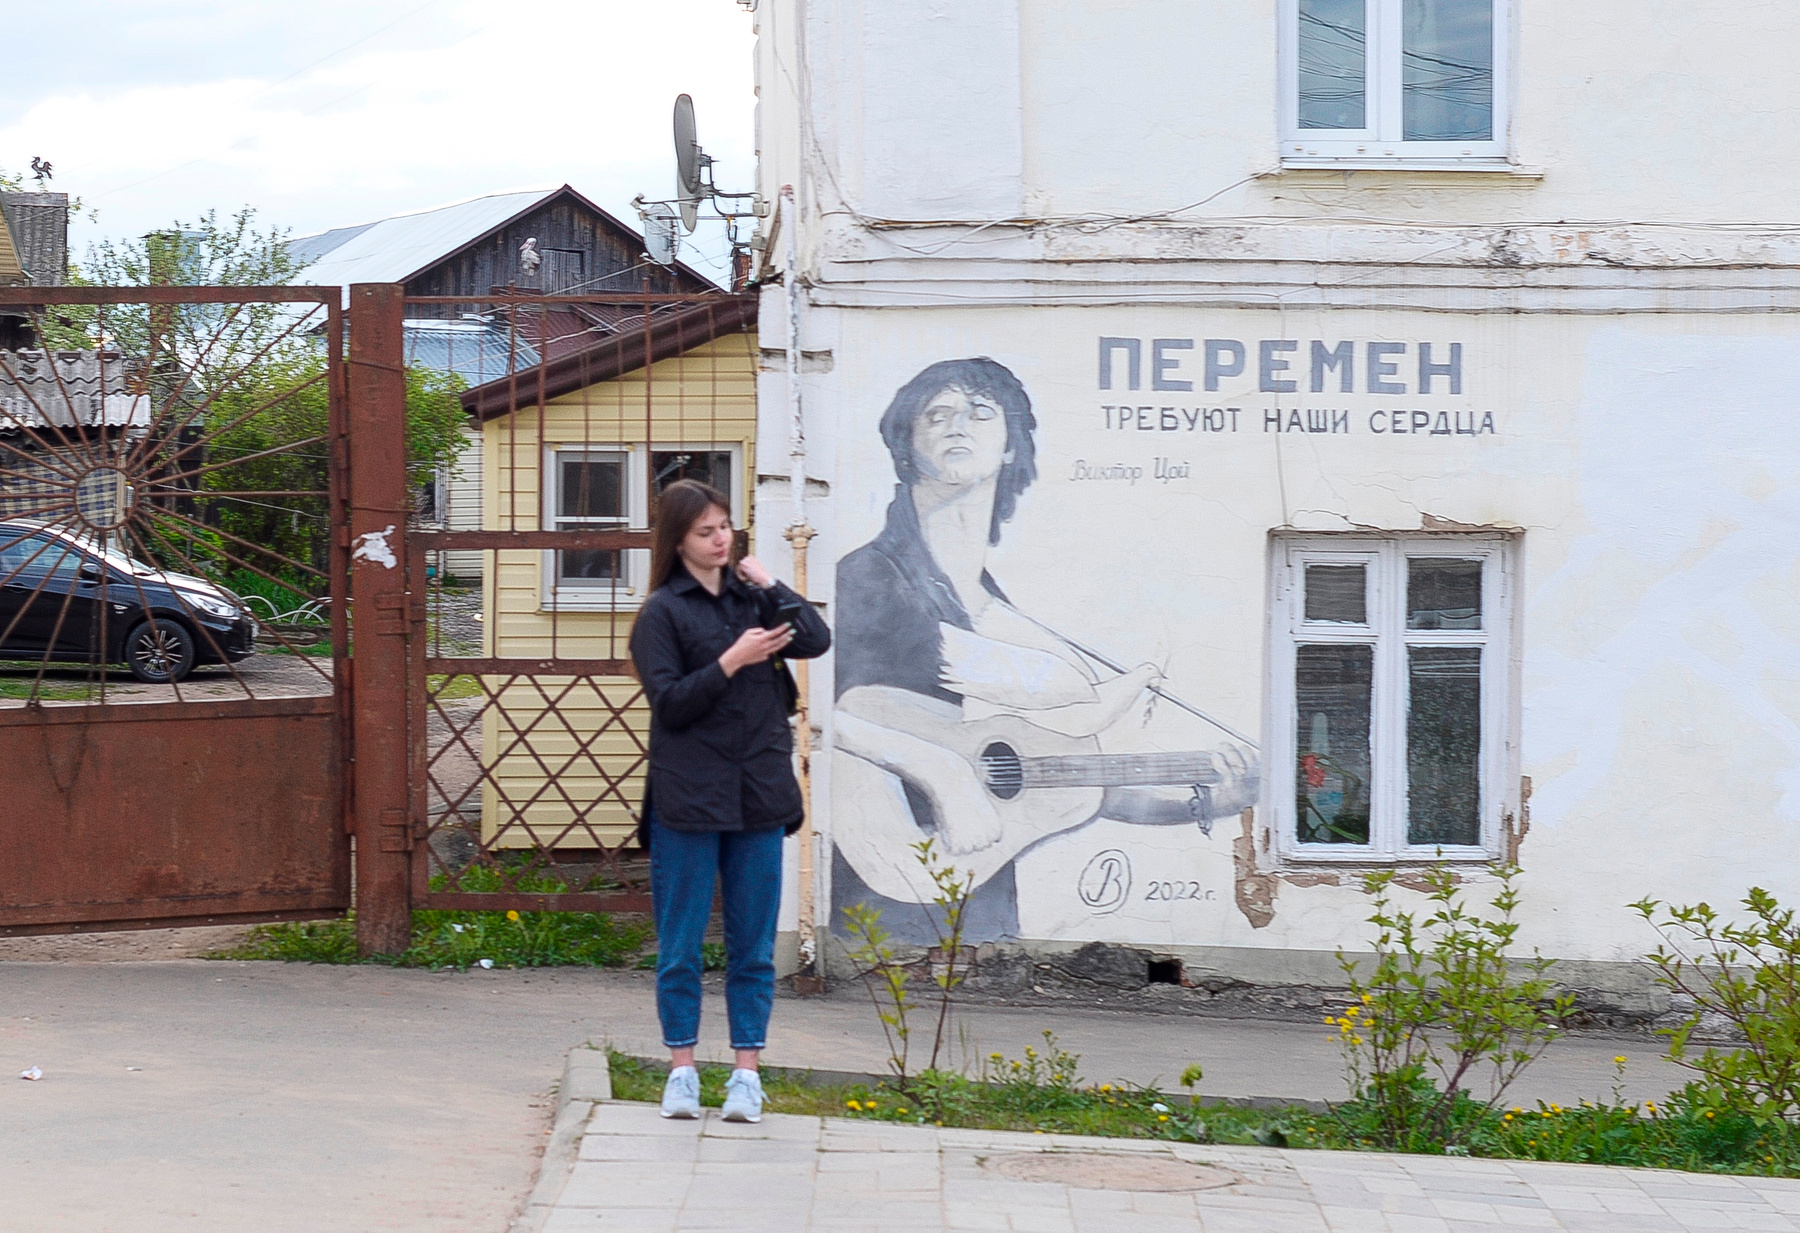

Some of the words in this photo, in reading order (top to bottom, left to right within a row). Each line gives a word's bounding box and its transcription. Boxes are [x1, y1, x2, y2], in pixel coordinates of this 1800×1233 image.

[1099, 336, 1463, 394] ПЕРЕМЕН
[1101, 405, 1241, 433] ТРЕБУЮТ
[1263, 408, 1349, 434] НАШИ
[1369, 410, 1496, 437] СЕРДЦА
[1069, 458, 1143, 485] Виктор
[1153, 457, 1190, 484] Цой
[1145, 881, 1217, 901] 2022г.
